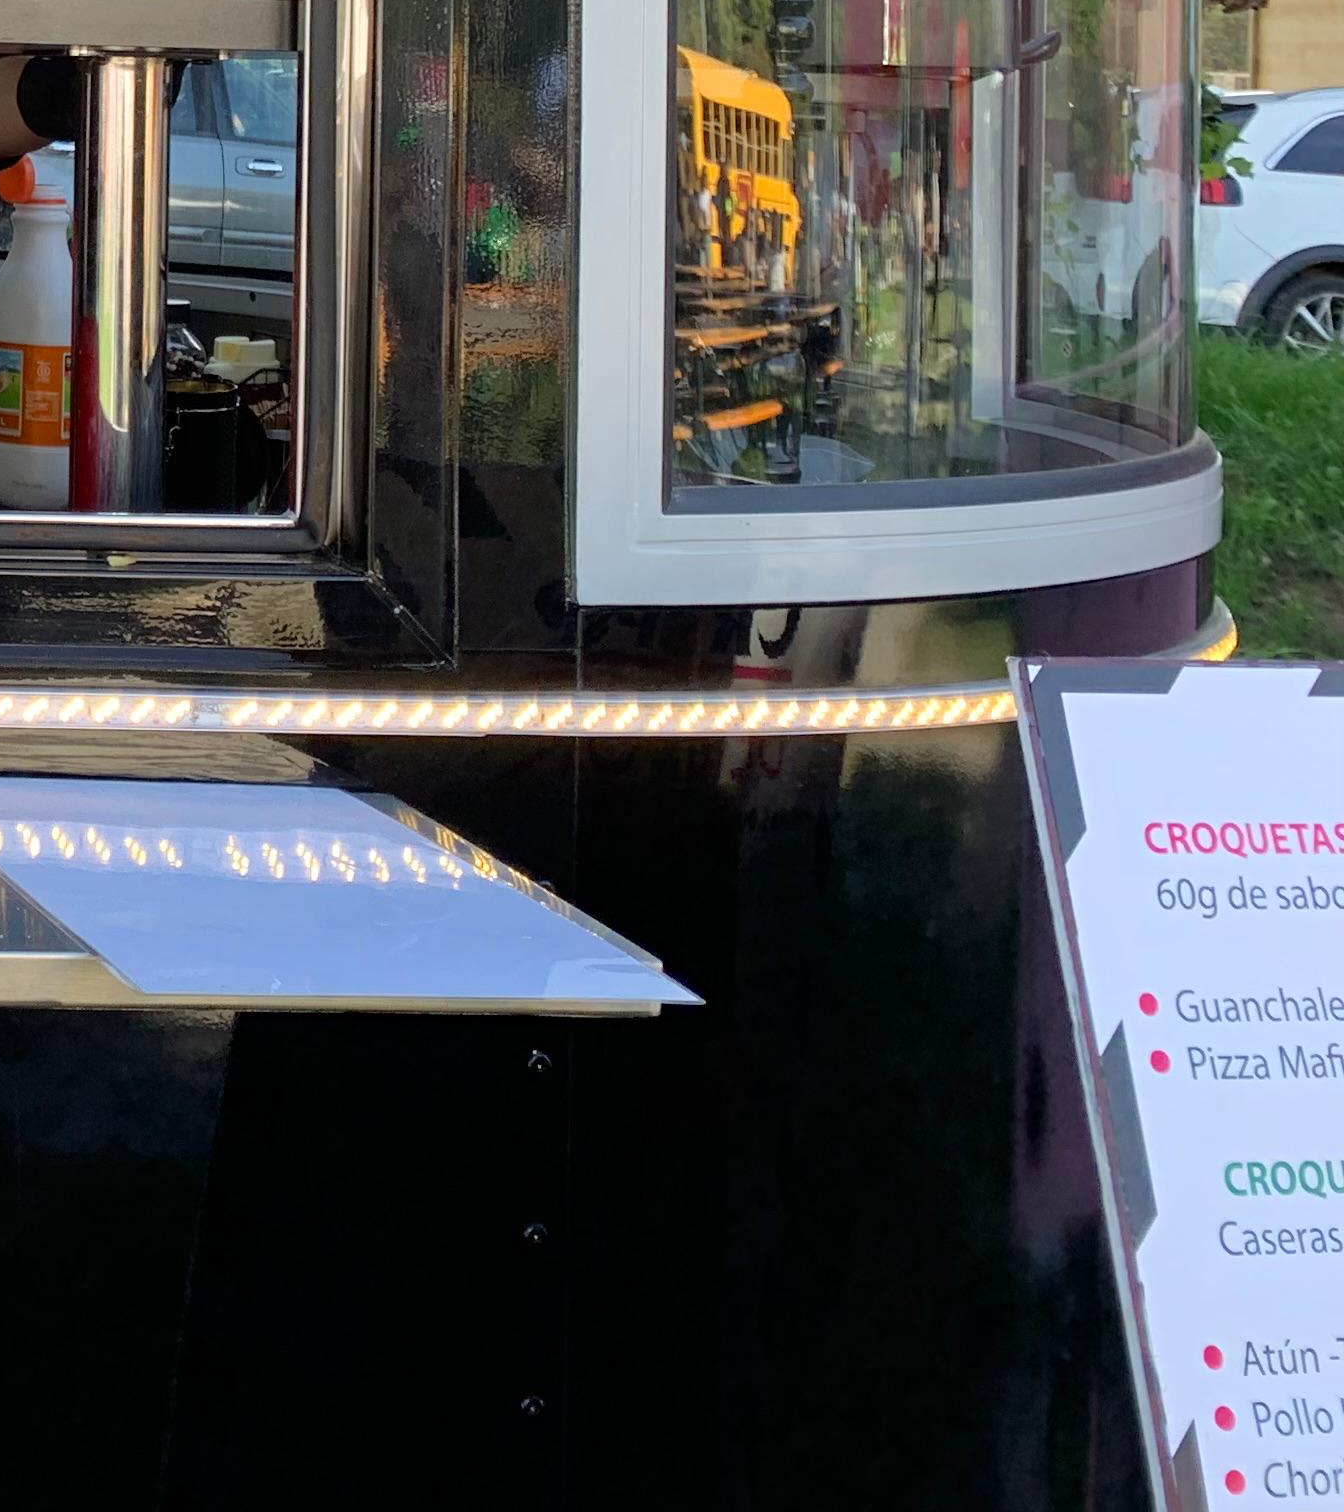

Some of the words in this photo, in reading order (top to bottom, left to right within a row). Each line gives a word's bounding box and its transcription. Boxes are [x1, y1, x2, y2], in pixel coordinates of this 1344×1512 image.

[1157, 878, 1218, 919] 60g
[1228, 876, 1268, 910] de
[1187, 1046, 1271, 1080] Pizza
[1218, 1220, 1343, 1256] Caseras
[1243, 1339, 1320, 1376] Atún
[1251, 1398, 1334, 1437] Pollo
